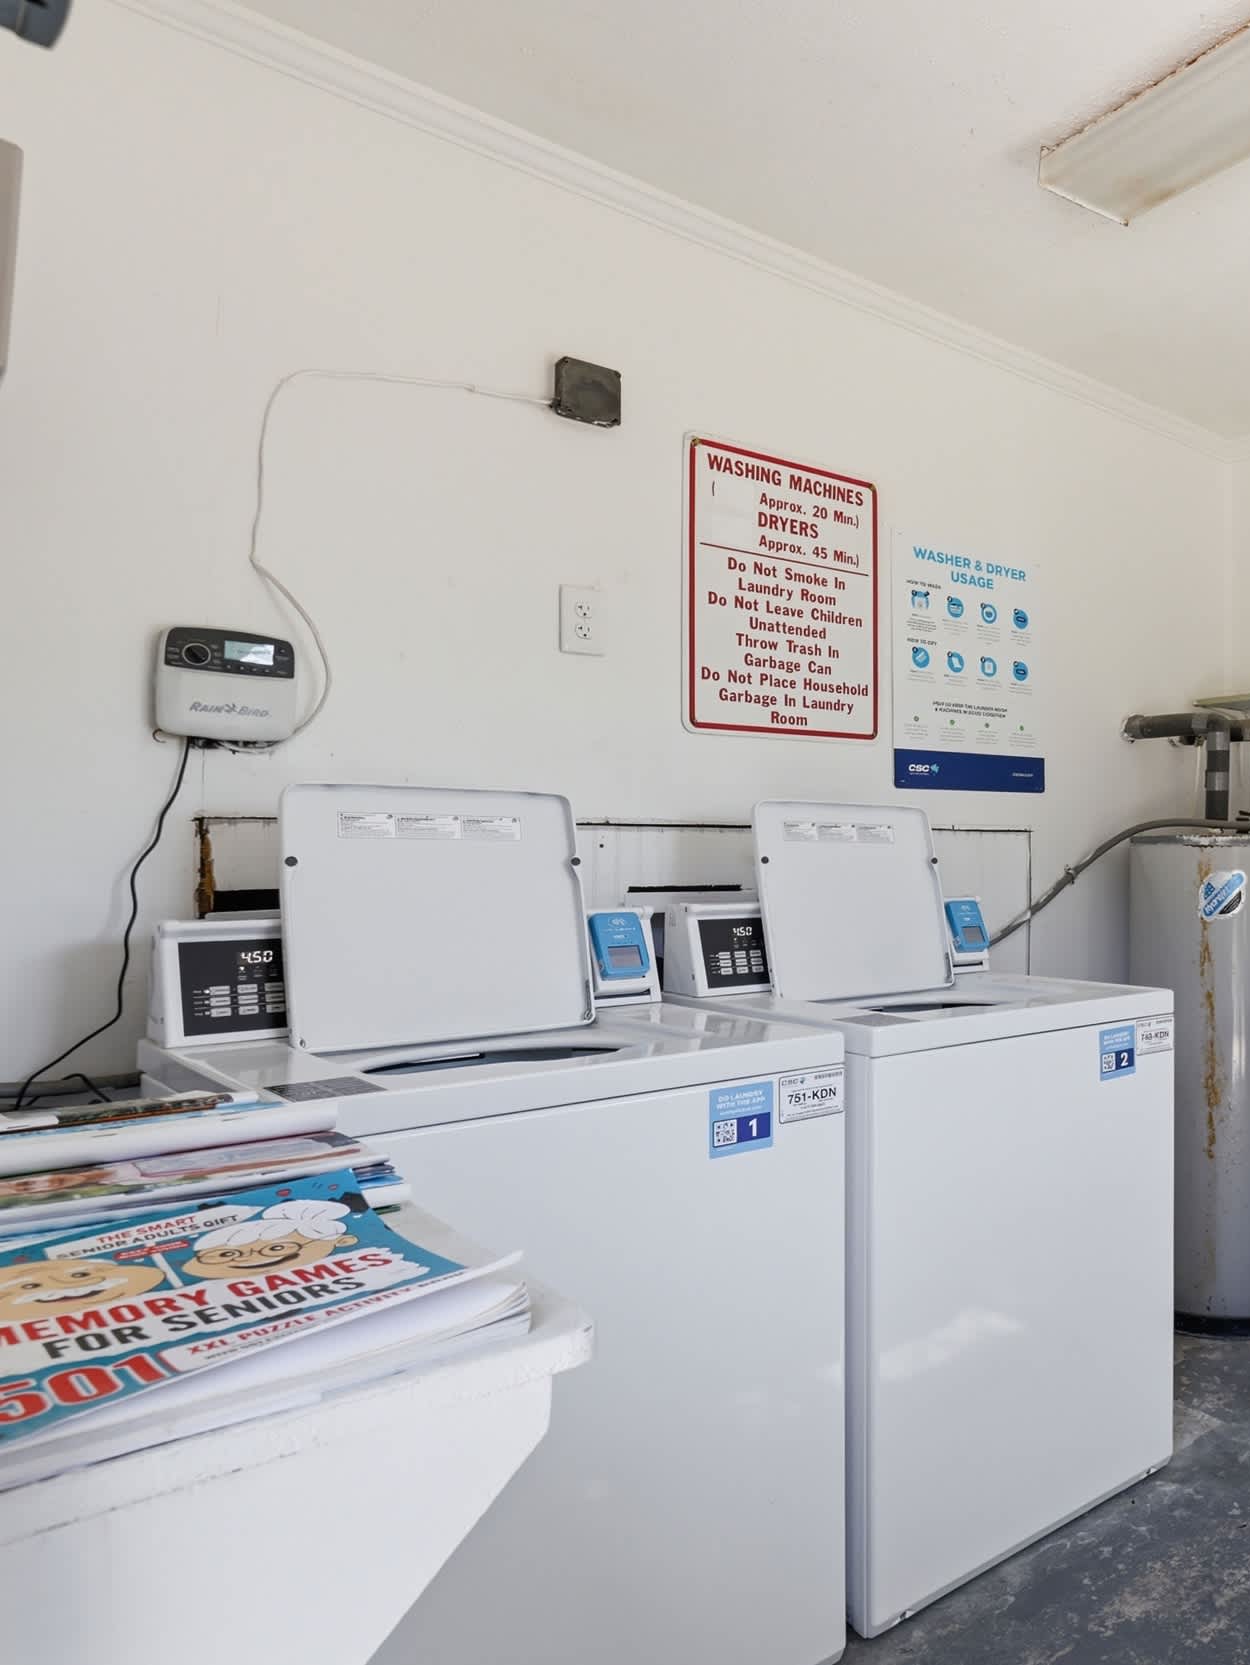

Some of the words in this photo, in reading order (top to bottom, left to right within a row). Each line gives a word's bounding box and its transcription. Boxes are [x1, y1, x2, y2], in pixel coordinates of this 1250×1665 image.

[707, 453, 782, 486] WASHING
[789, 474, 863, 506] MACHINES
[759, 493, 806, 516] Approx.
[812, 505, 828, 520] 20
[758, 511, 819, 539] DRYERS
[759, 535, 806, 556] Approx.
[812, 546, 828, 560] 45
[727, 557, 746, 572] Do
[753, 561, 778, 578] Not
[785, 568, 828, 588] Smoke
[834, 577, 846, 590] In
[913, 546, 972, 569] WASHER
[974, 560, 983, 572] &
[986, 563, 1026, 581] DRYER
[738, 577, 794, 601] Laundry
[801, 588, 836, 606] Room
[951, 570, 994, 589] USAGE
[708, 591, 727, 606] Do
[734, 596, 759, 611] Not
[766, 601, 804, 618] Leave
[811, 608, 863, 628] Children
[749, 616, 826, 639] Unattended
[736, 632, 778, 650] Throw
[786, 639, 822, 656] Trash
[828, 646, 839, 659] In
[744, 653, 801, 673] Garbage
[808, 660, 832, 675] Can
[701, 666, 720, 681] Do
[728, 669, 753, 685] Not
[760, 673, 796, 689] Place
[803, 678, 868, 697] Household
[719, 688, 777, 708] Garbage
[784, 694, 796, 707] In
[803, 696, 854, 715] Laundry
[771, 711, 808, 726] Room
[908, 763, 930, 773] CSC
[1120, 1052, 1129, 1067] 2
[787, 1087, 837, 1105] 751-KDN
[748, 1118, 758, 1137] 1
[56, 1238, 131, 1260] SENIOR
[132, 1223, 201, 1245] ADULTS
[96, 1230, 132, 1244] THE
[135, 1215, 197, 1235] SMART
[227, 1253, 393, 1298] GAMES
[43, 1325, 151, 1360] FOR
[161, 1276, 366, 1333] SENIORS
[238, 1315, 316, 1341] PUZZLE
[325, 1287, 413, 1317] ACTIVITY
[0, 1353, 168, 1424] 501
